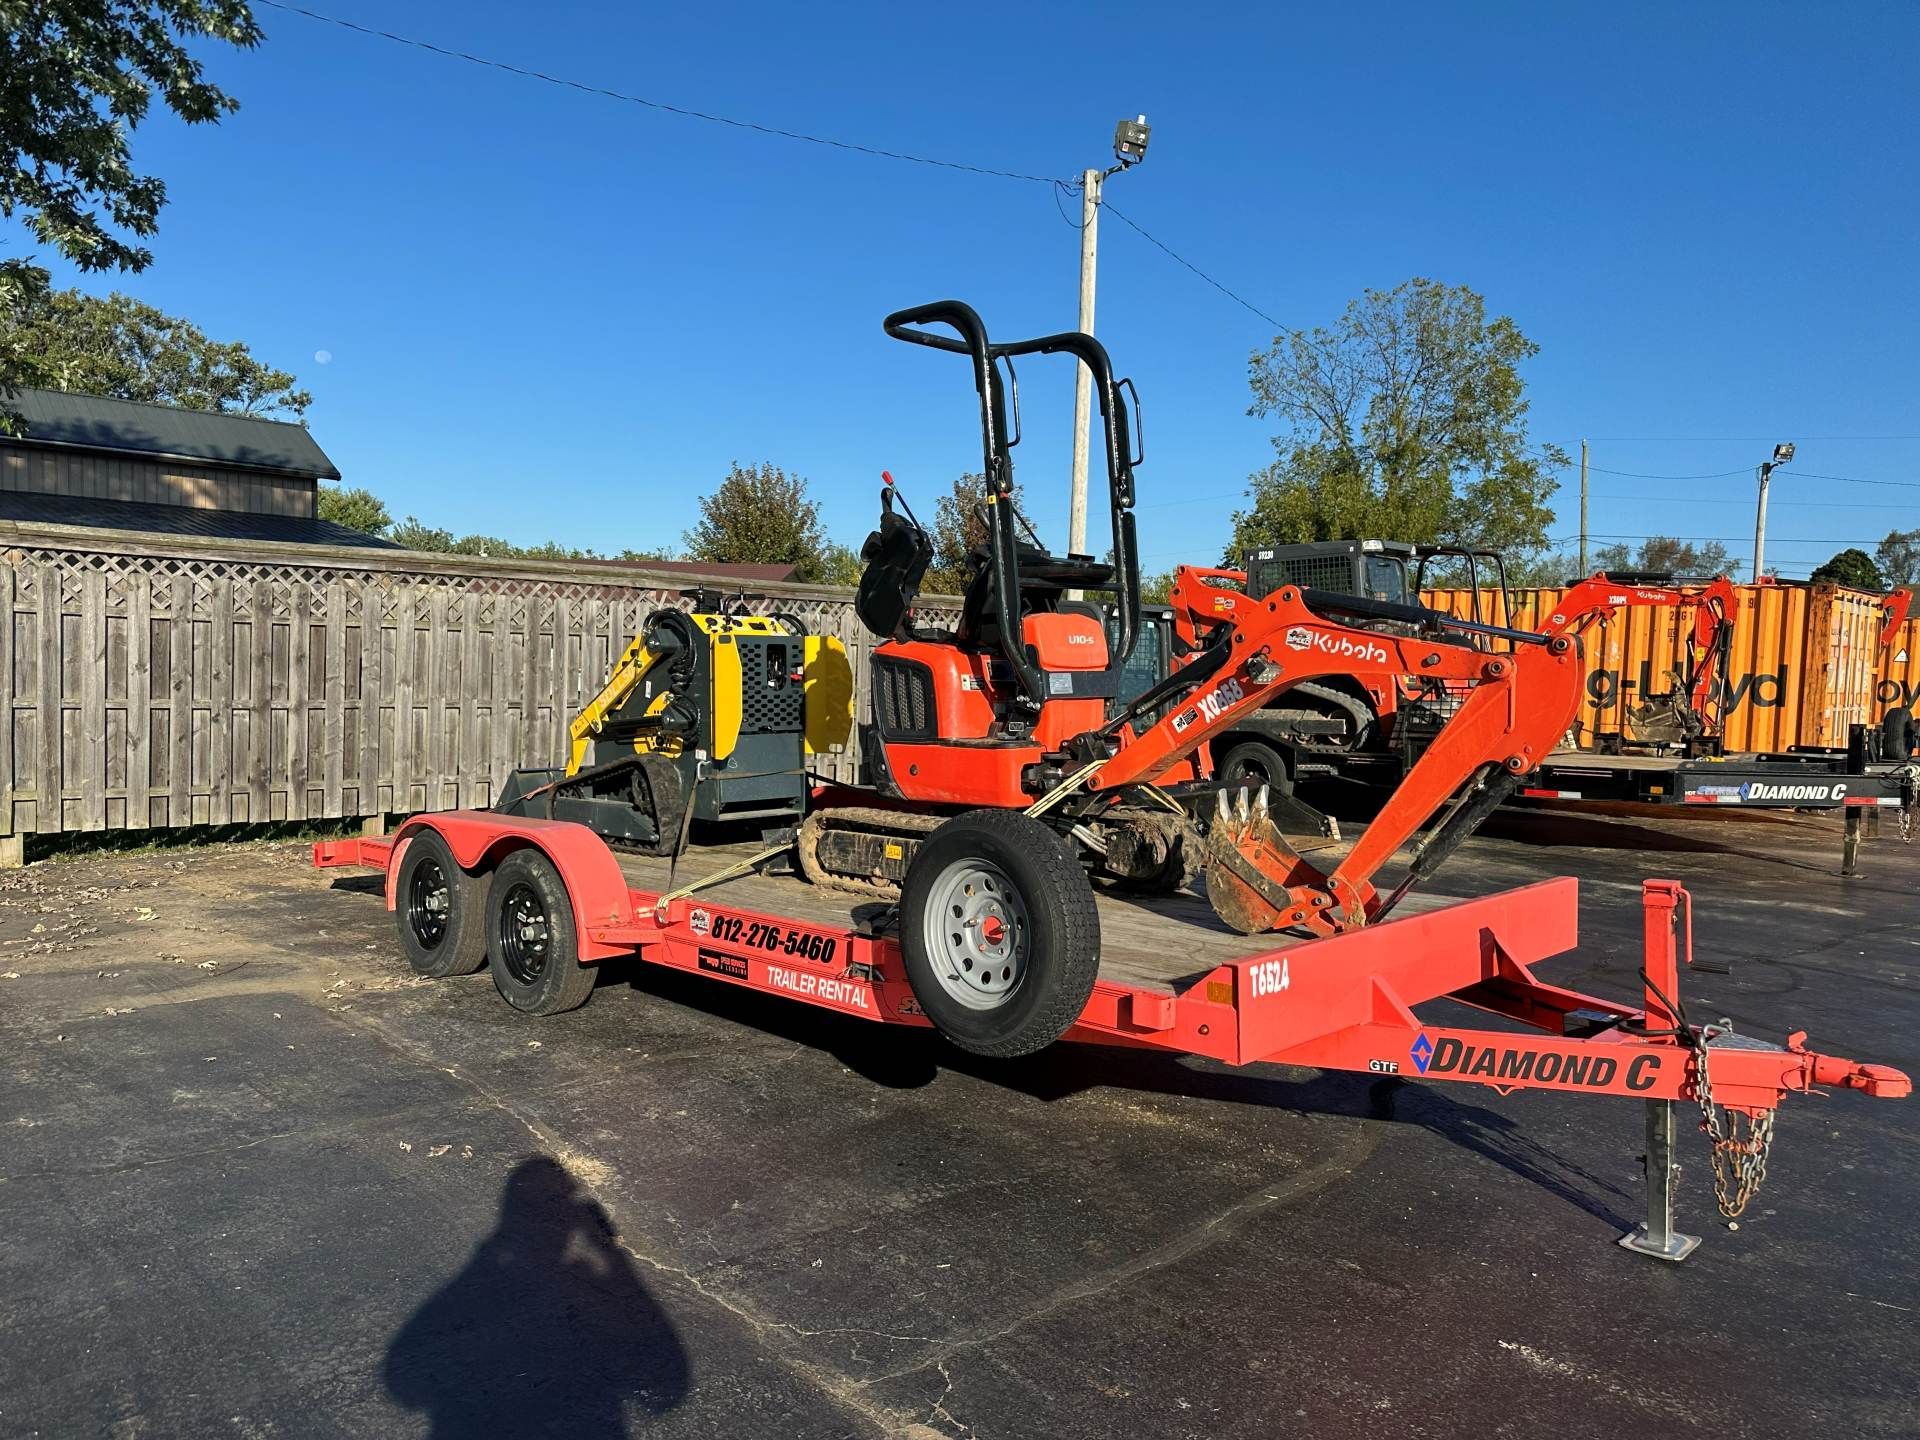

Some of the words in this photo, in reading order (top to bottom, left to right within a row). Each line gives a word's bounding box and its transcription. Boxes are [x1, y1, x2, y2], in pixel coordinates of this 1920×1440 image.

[1637, 591, 1666, 601] Kubota
[1313, 632, 1387, 664] Kubota
[1748, 782, 1829, 801] DIAMOND
[1831, 784, 1847, 801] C
[711, 914, 837, 964] 812-276-5460
[767, 966, 816, 995] TRAILER
[817, 978, 869, 1008] RENTAL
[1370, 1060, 1398, 1073] GTF
[1427, 1037, 1618, 1087] DIAMOND
[1624, 1054, 1663, 1092] C
